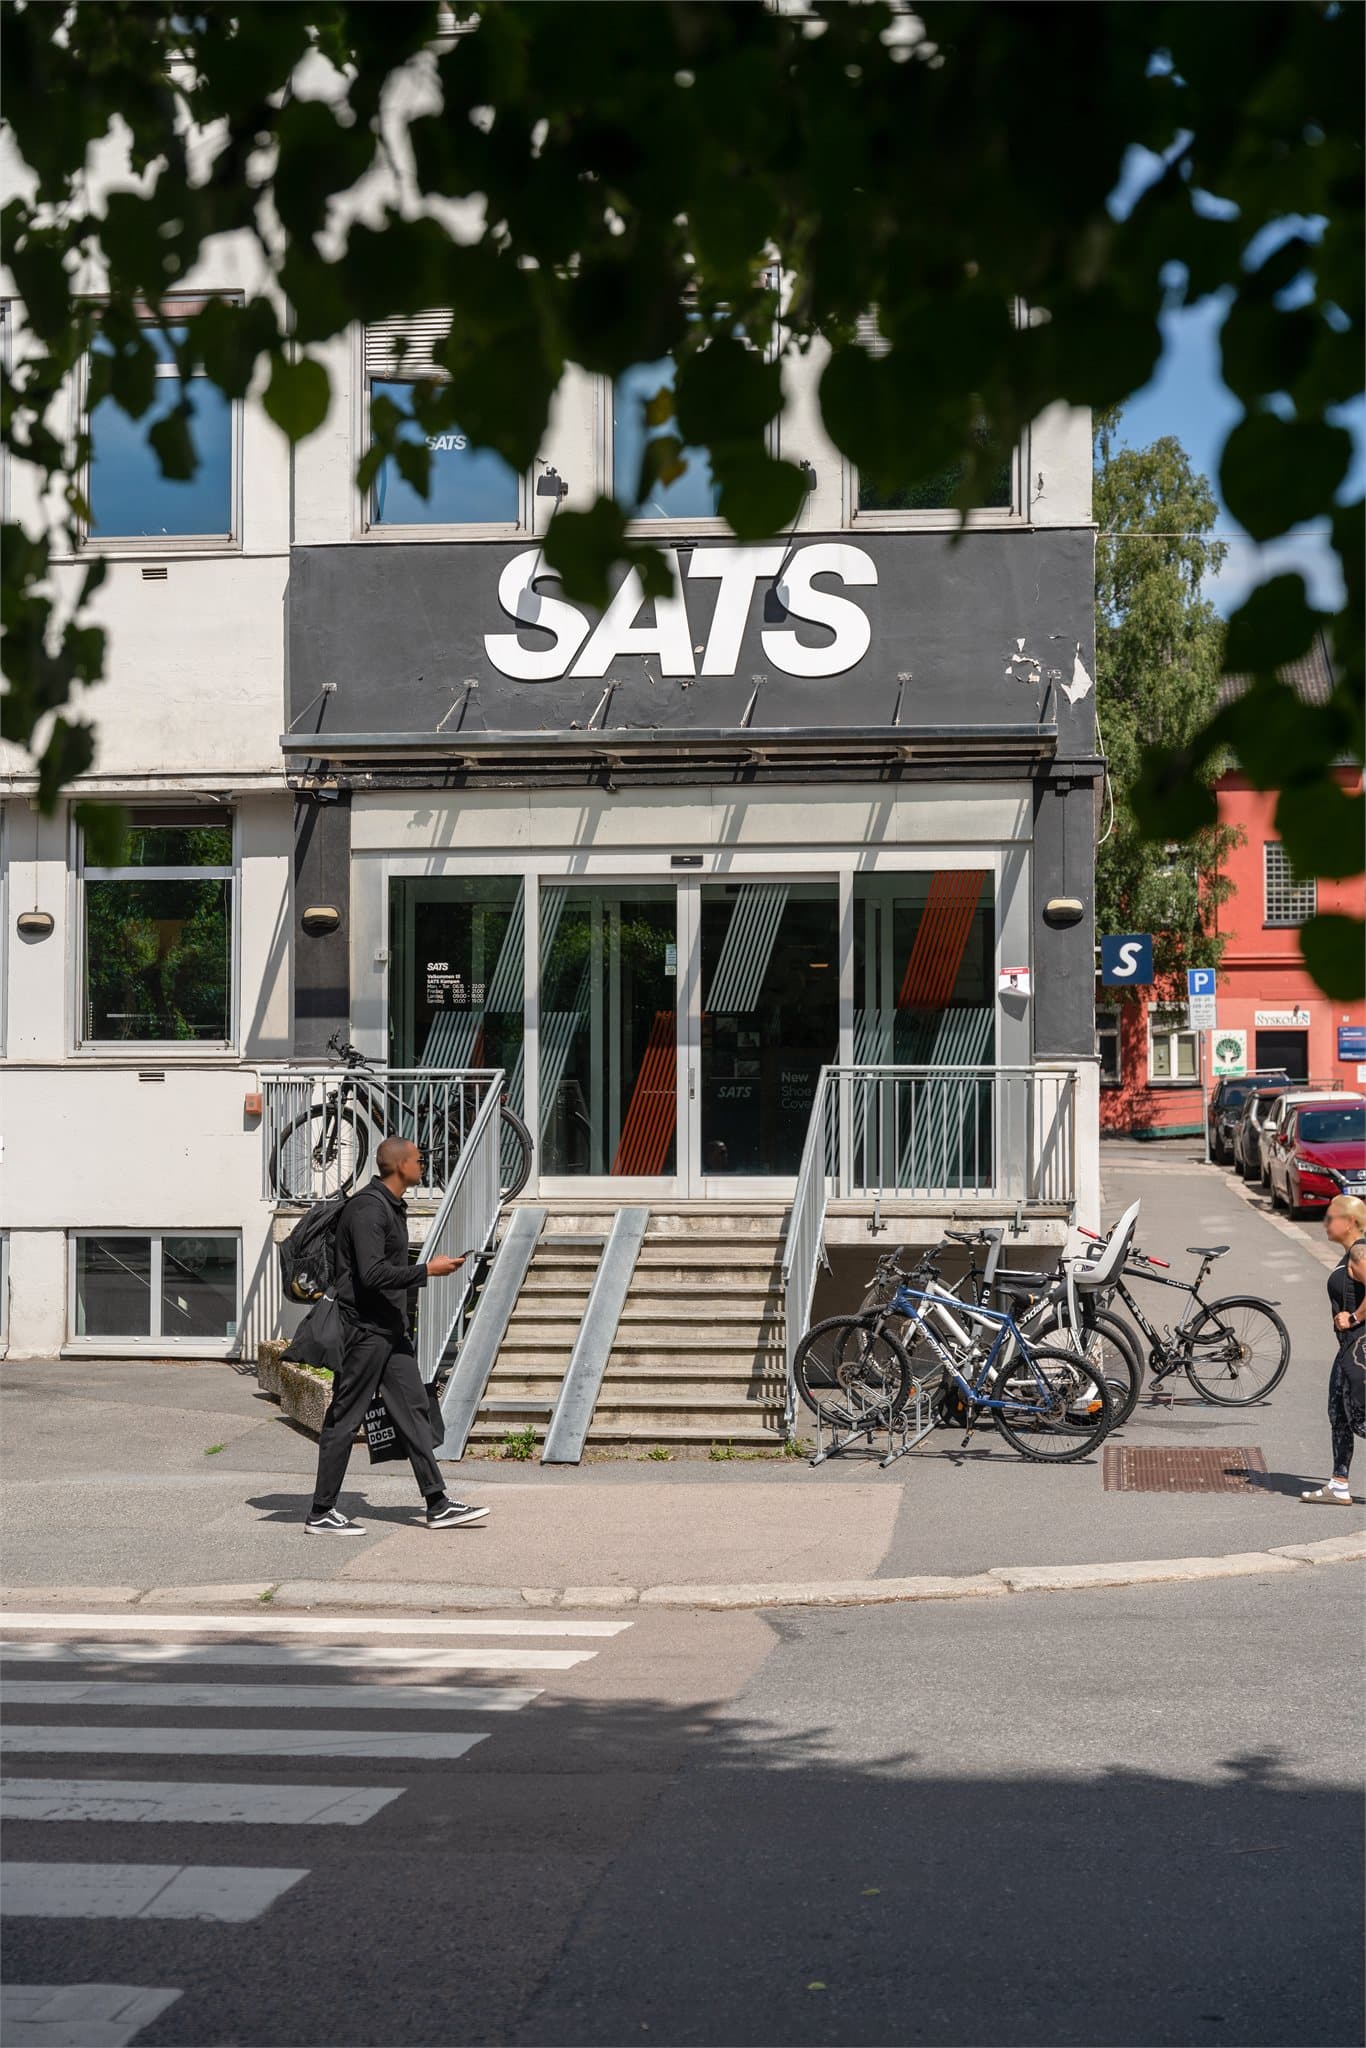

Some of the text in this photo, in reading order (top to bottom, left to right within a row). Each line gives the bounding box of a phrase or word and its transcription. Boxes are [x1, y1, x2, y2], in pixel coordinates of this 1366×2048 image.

[425, 435, 467, 450] SATS
[484, 543, 878, 680] SATS
[1112, 942, 1143, 977] S
[427, 962, 449, 971] SATS
[1195, 972, 1209, 993] P
[1256, 1015, 1309, 1026] NYSKOLEN
[781, 1071, 809, 1082] New
[717, 1086, 753, 1098] SATS
[781, 1086, 812, 1097] Shoe
[781, 1099, 811, 1110] Cove
[980, 1289, 992, 1309] IRD
[367, 1420, 381, 1432] MY
[370, 1429, 393, 1442] DOCS
